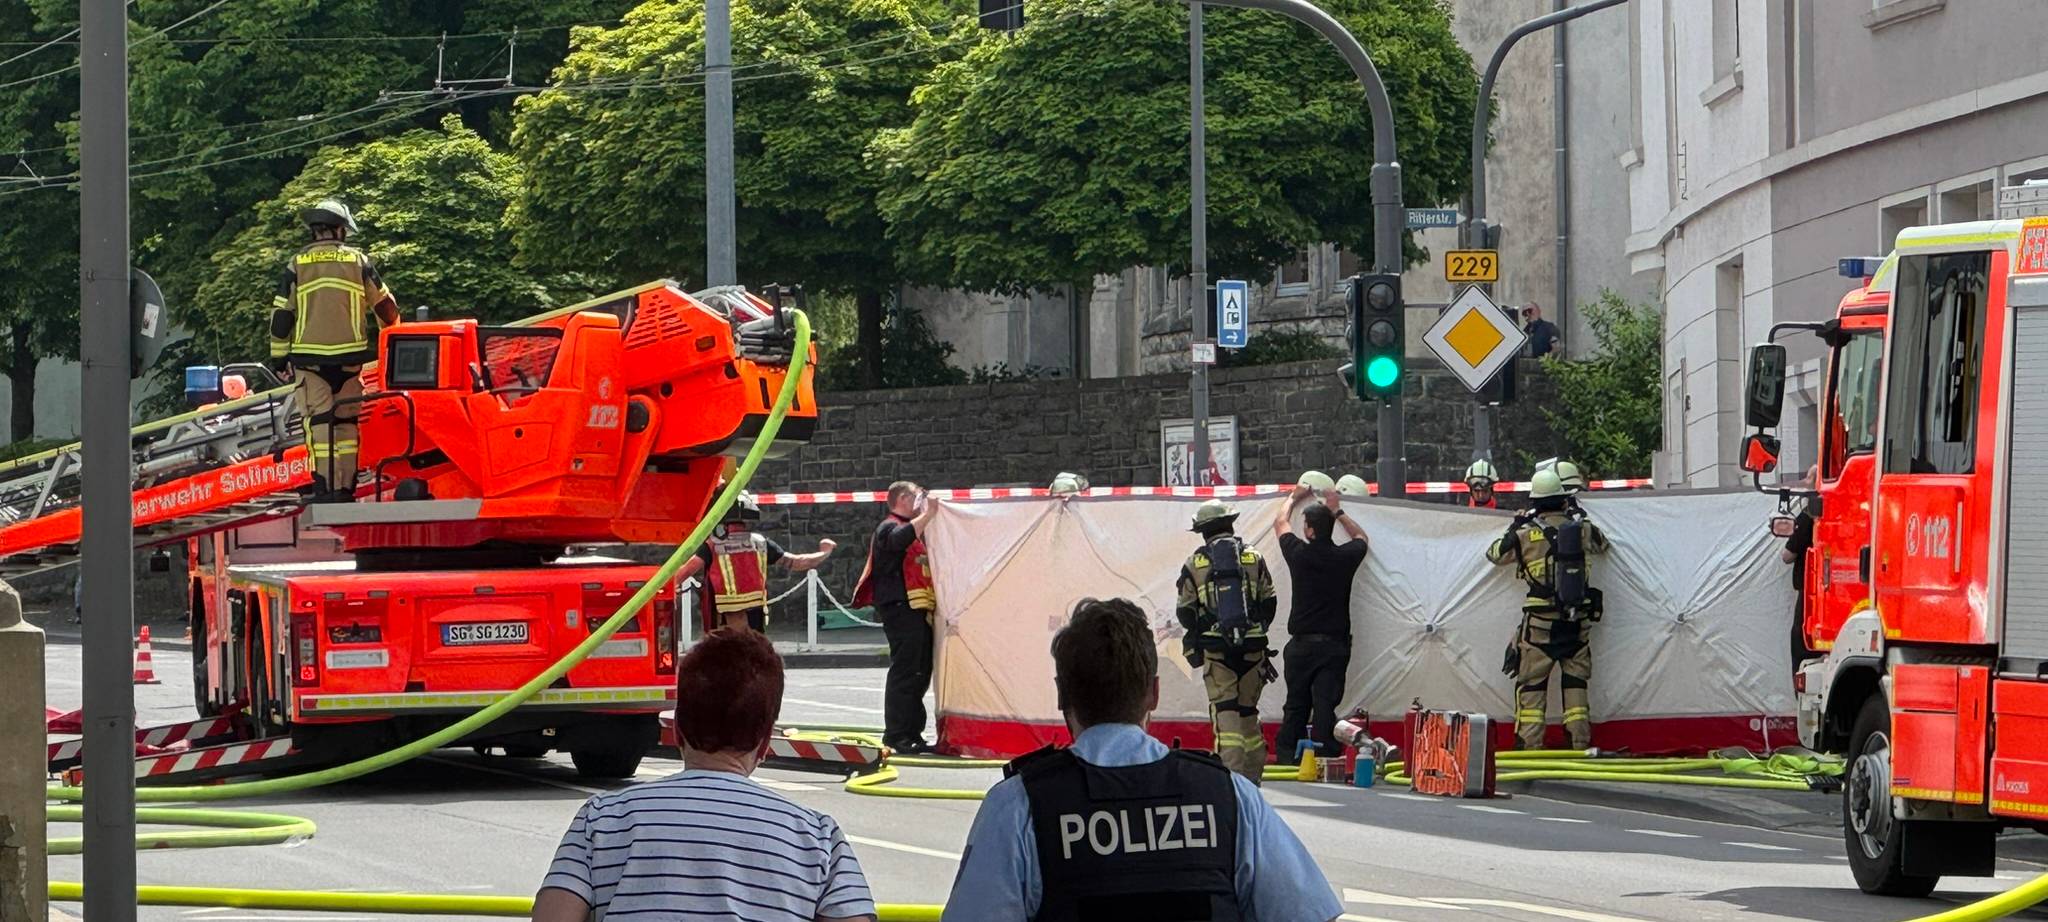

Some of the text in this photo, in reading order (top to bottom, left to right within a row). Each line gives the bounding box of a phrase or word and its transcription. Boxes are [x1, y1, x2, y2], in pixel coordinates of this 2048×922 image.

[1408, 211, 1452, 225] Ritterstr.
[1452, 256, 1491, 276] 229
[131, 479, 214, 518] erwehr
[1924, 516, 1949, 559] 112
[451, 624, 525, 640] SG SG 1230
[1059, 804, 1217, 859] POLIZEI
